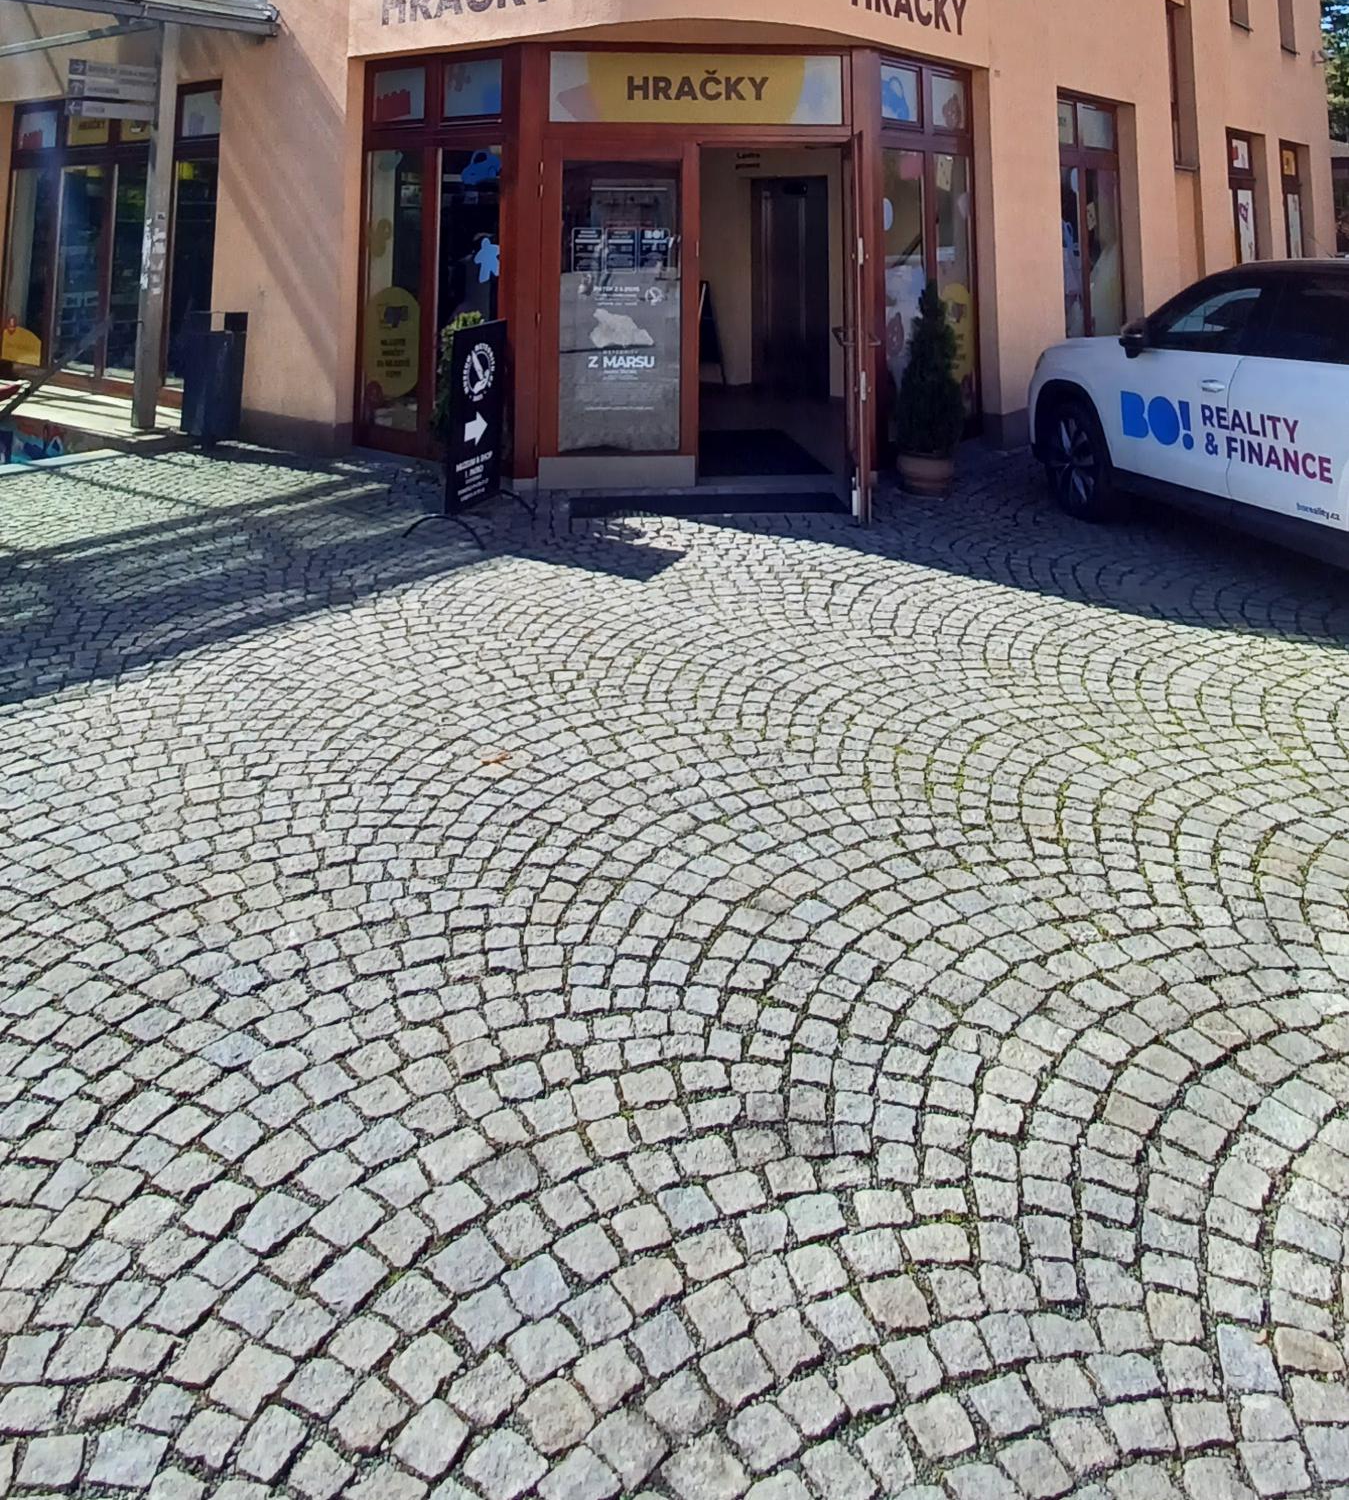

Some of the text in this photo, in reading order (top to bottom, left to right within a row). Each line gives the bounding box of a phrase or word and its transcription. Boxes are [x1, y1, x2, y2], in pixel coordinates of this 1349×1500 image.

[626, 69, 769, 102] HRAČKY
[587, 355, 655, 369] Z MARSU
[1120, 389, 1195, 451] BO!
[1200, 403, 1299, 444] REALITY
[1204, 432, 1334, 485] & FINANCE
